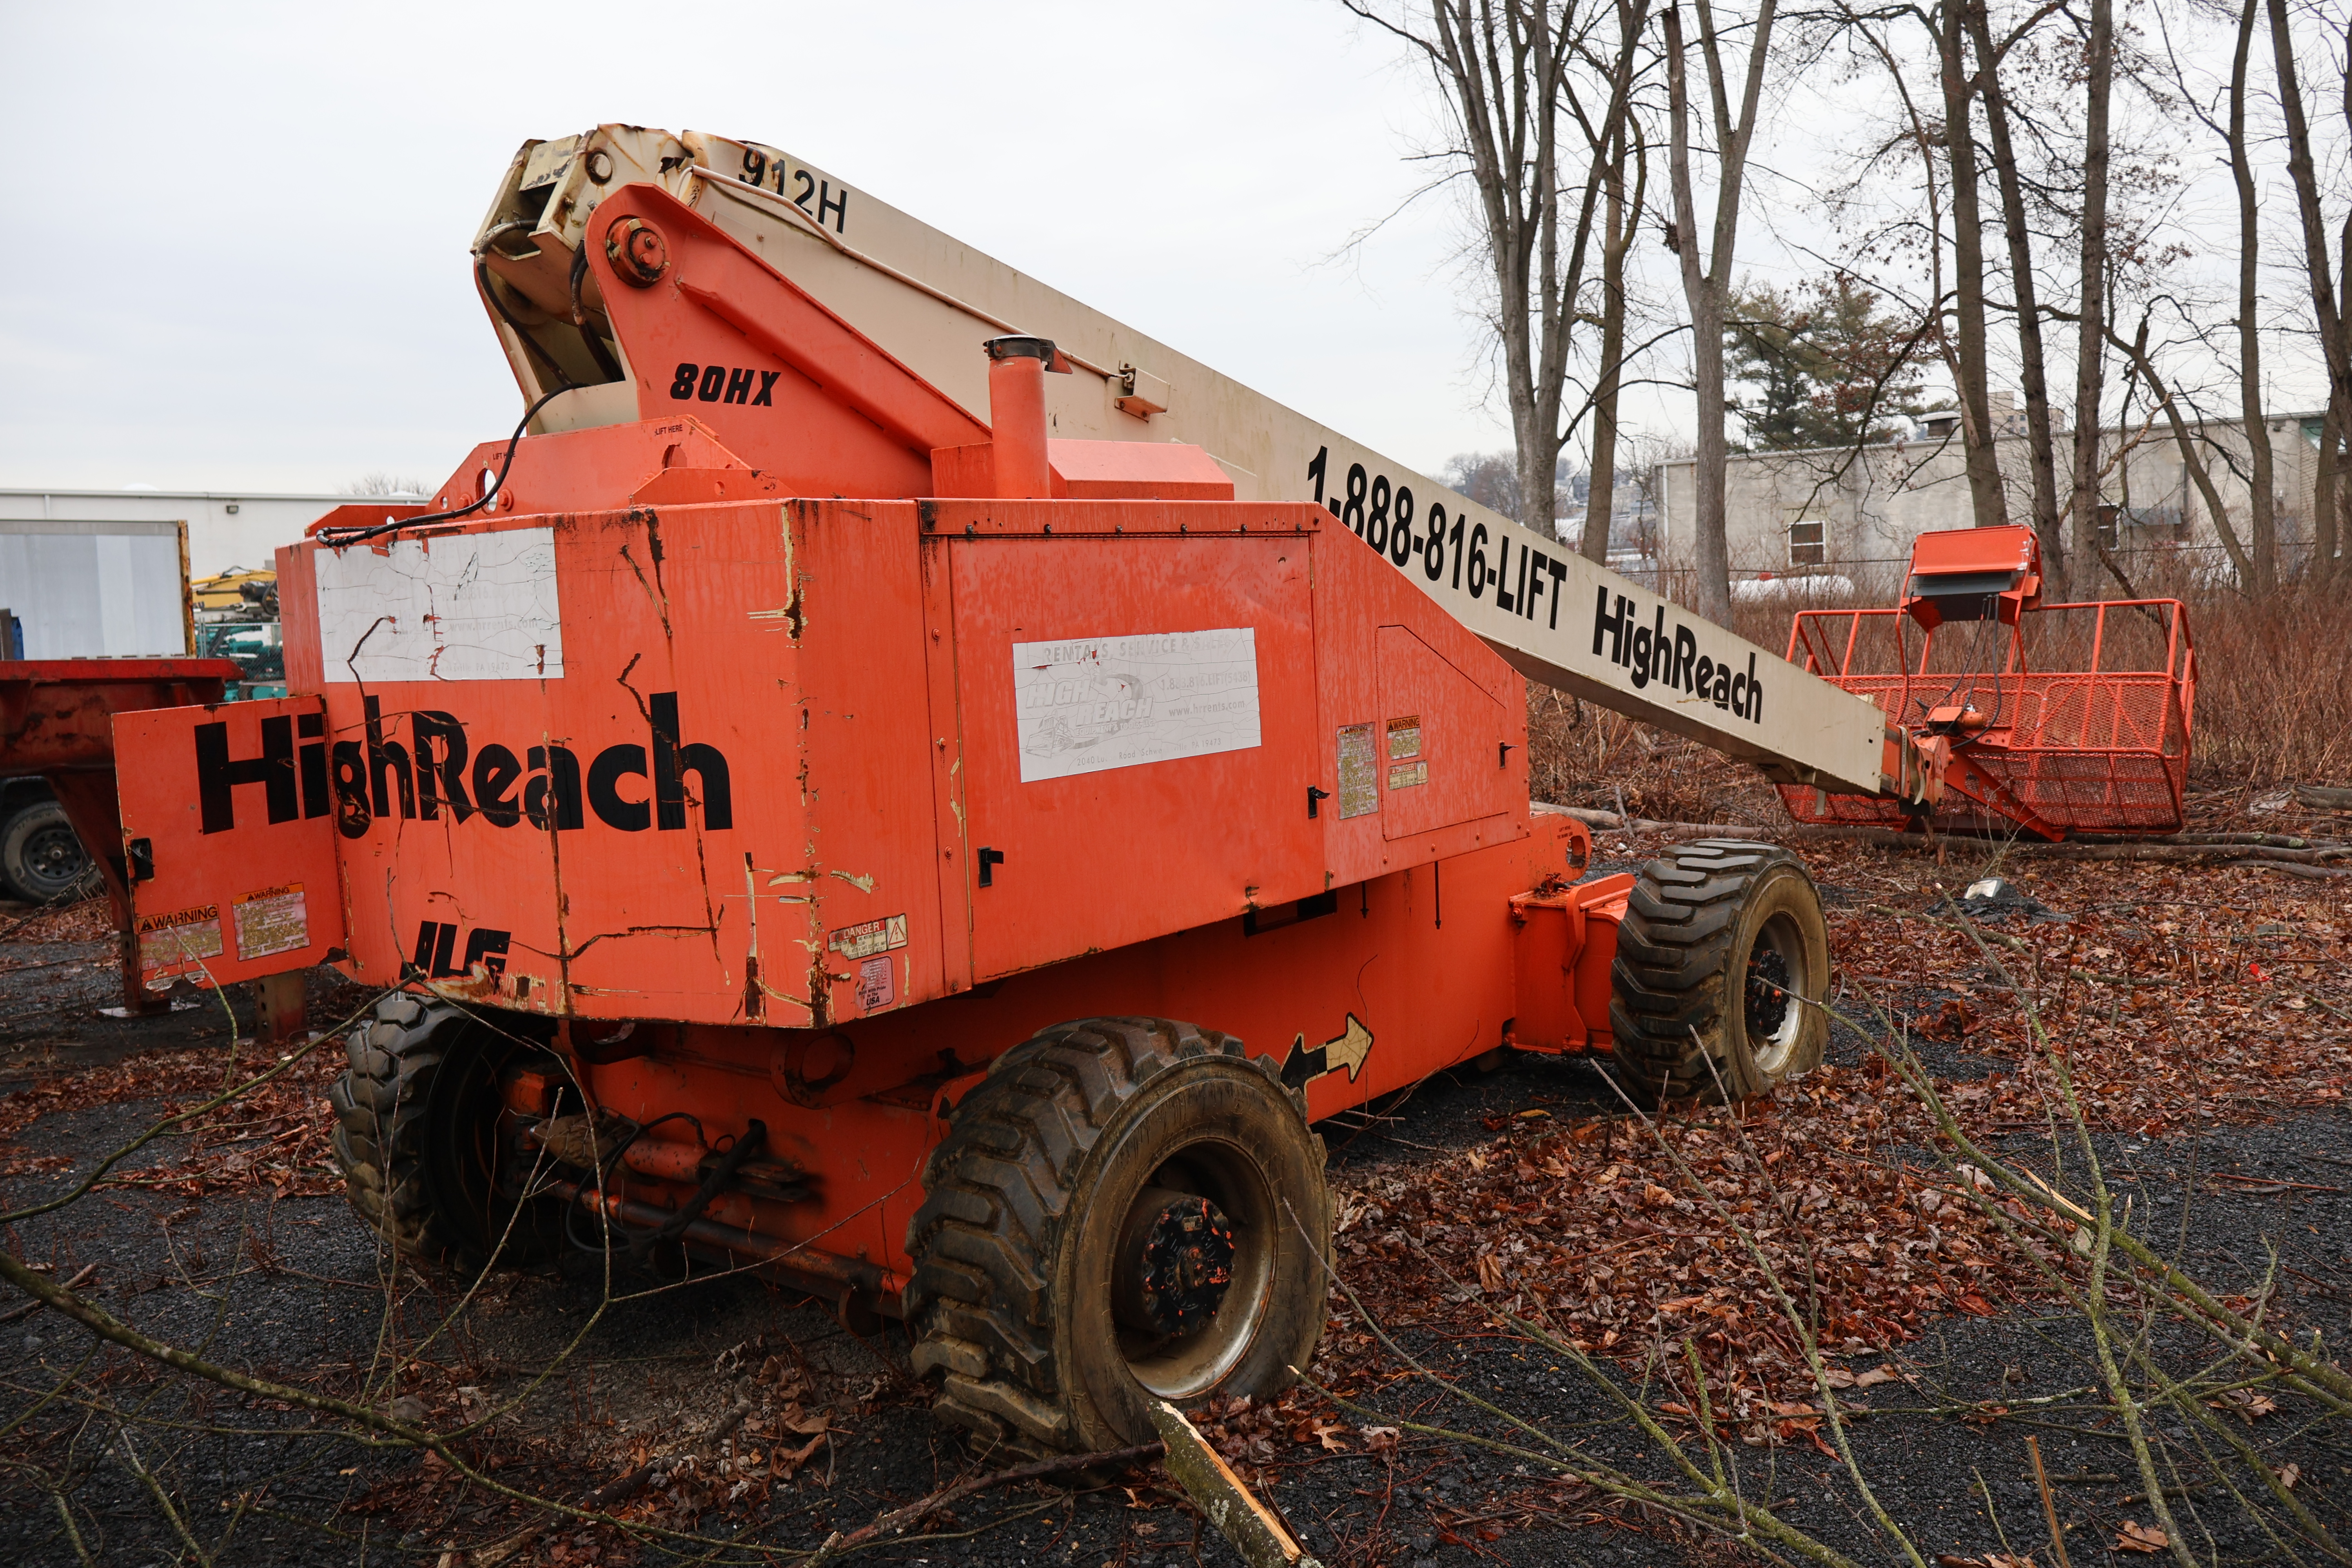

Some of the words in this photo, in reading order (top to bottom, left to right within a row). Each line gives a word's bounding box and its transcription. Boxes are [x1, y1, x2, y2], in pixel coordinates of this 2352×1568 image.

[738, 145, 848, 234] 912H
[670, 363, 782, 407] 80HX
[655, 426, 666, 435] LIFT
[668, 424, 683, 433] HERE
[1308, 446, 1568, 630] 1-888-816-LIFT
[1119, 638, 1176, 657] SERVICE
[1181, 638, 1189, 651] &
[1592, 585, 1763, 724] HighReach
[488, 662, 510, 671] 19473
[1025, 679, 1092, 709] HIGH
[1075, 696, 1154, 726] REACH
[1169, 701, 1245, 717] www.hrrents.com
[1348, 724, 1368, 733] WARNING
[1393, 717, 1420, 730] WARNING
[1077, 756, 1094, 766] 2040
[1119, 750, 1136, 760] Road
[1202, 738, 1221, 748] 19473
[195, 691, 733, 840] HighReach
[1396, 763, 1414, 773] DNGER
[254, 887, 289, 899] WARNING
[153, 906, 218, 927] WARNING
[844, 921, 880, 939] DANGER
[399, 920, 512, 996] JLG
[866, 995, 880, 1006] USA
